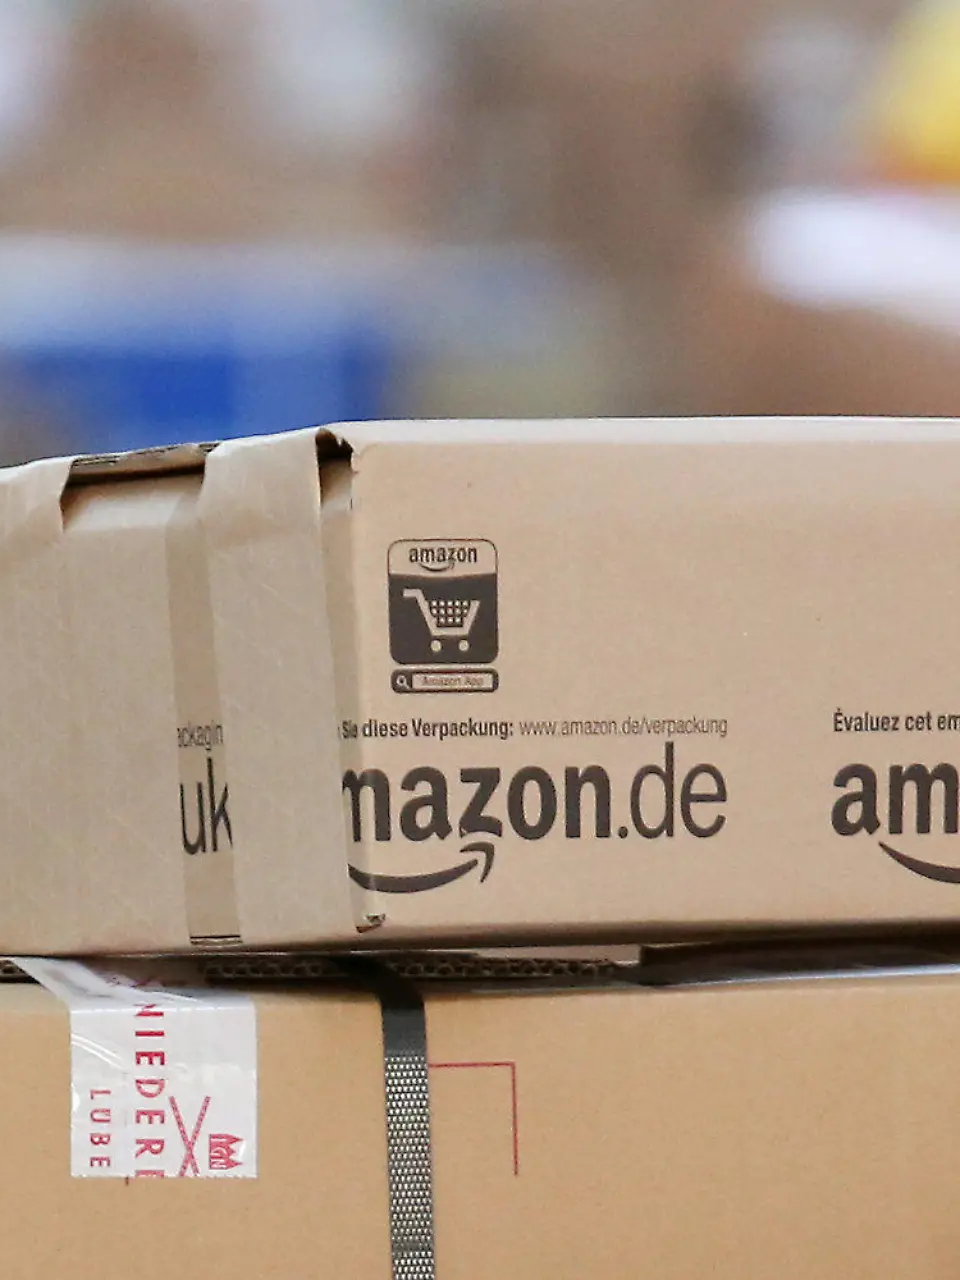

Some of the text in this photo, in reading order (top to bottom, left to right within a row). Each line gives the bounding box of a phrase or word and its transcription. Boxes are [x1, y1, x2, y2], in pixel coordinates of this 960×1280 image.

[409, 547, 477, 563] amazon
[362, 718, 408, 738] diese
[411, 717, 514, 741] Verpackung:
[519, 716, 729, 739] www.amazon.de/verpackung
[905, 711, 933, 731] cet
